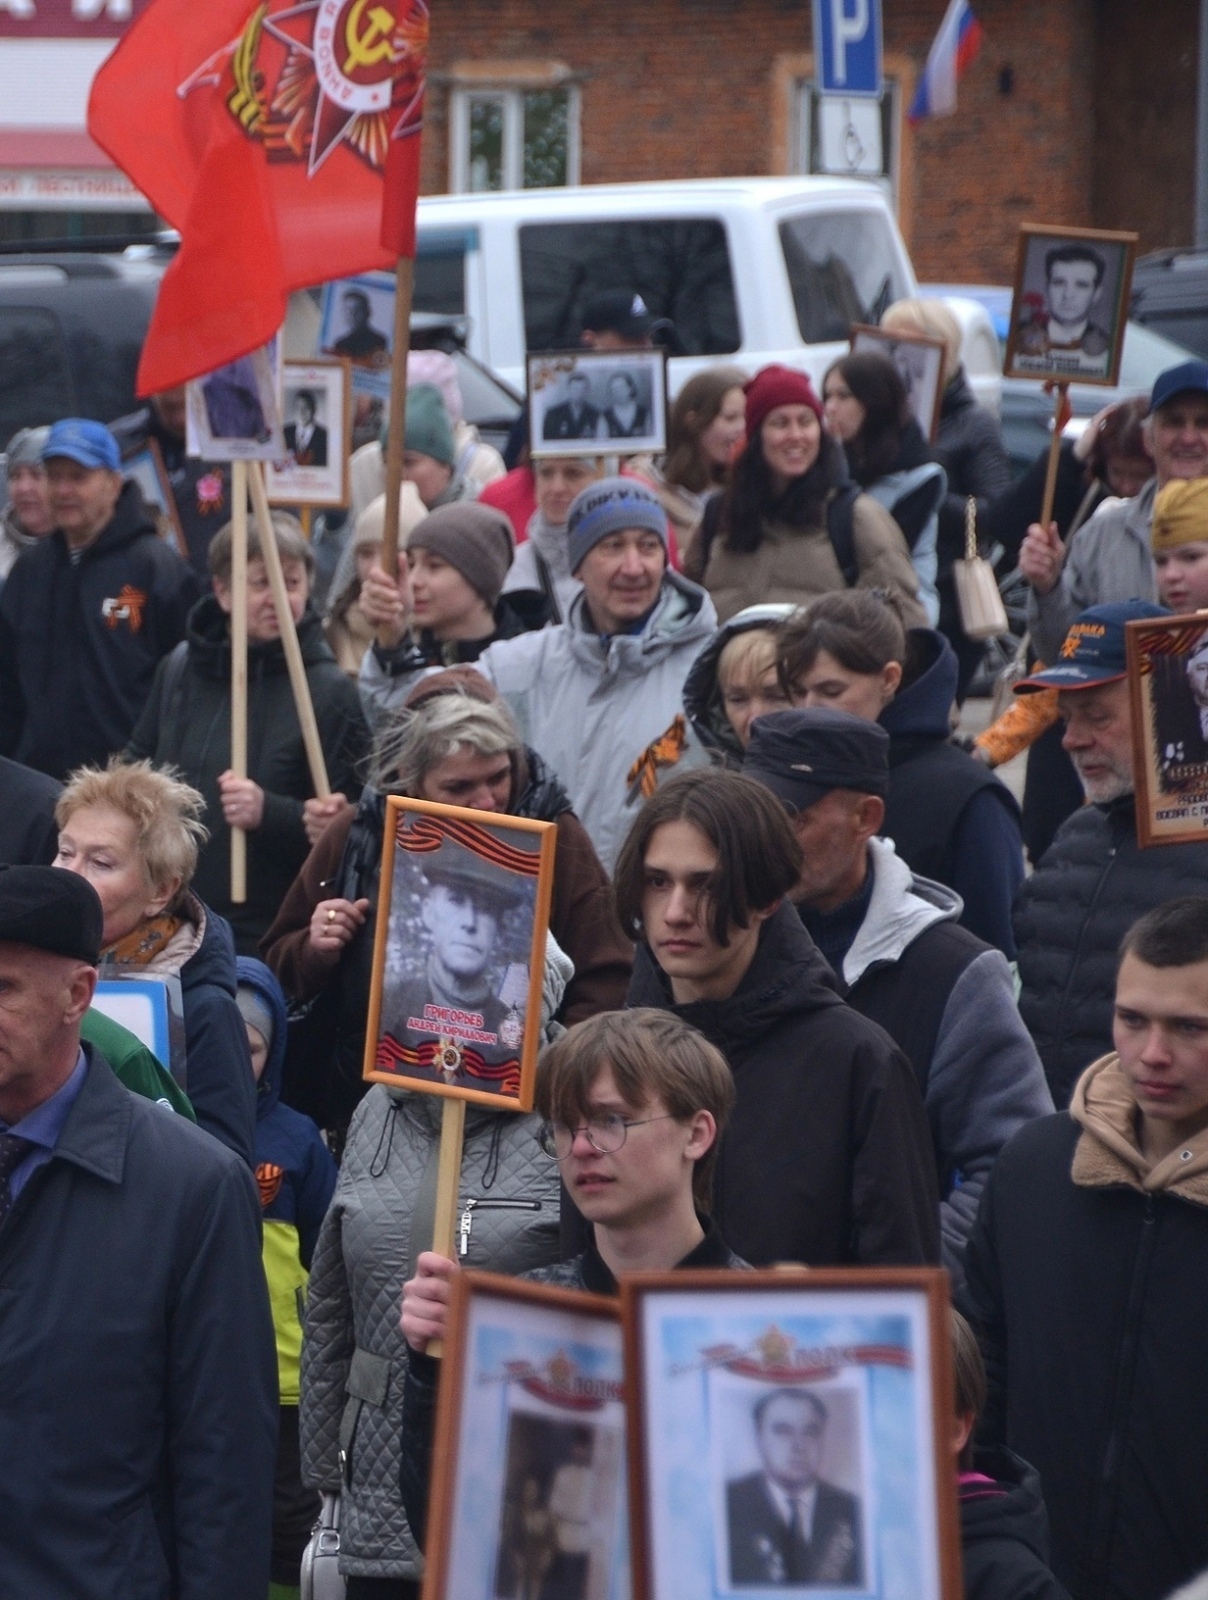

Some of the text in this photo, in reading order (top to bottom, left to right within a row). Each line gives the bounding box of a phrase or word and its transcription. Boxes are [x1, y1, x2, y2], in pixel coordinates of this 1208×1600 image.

[832, 0, 869, 84] P
[424, 1004, 484, 1028] ГРИГОРЬЕВ
[407, 1017, 497, 1045] АНДРЕЙ КИРИЛЛОВИЧ
